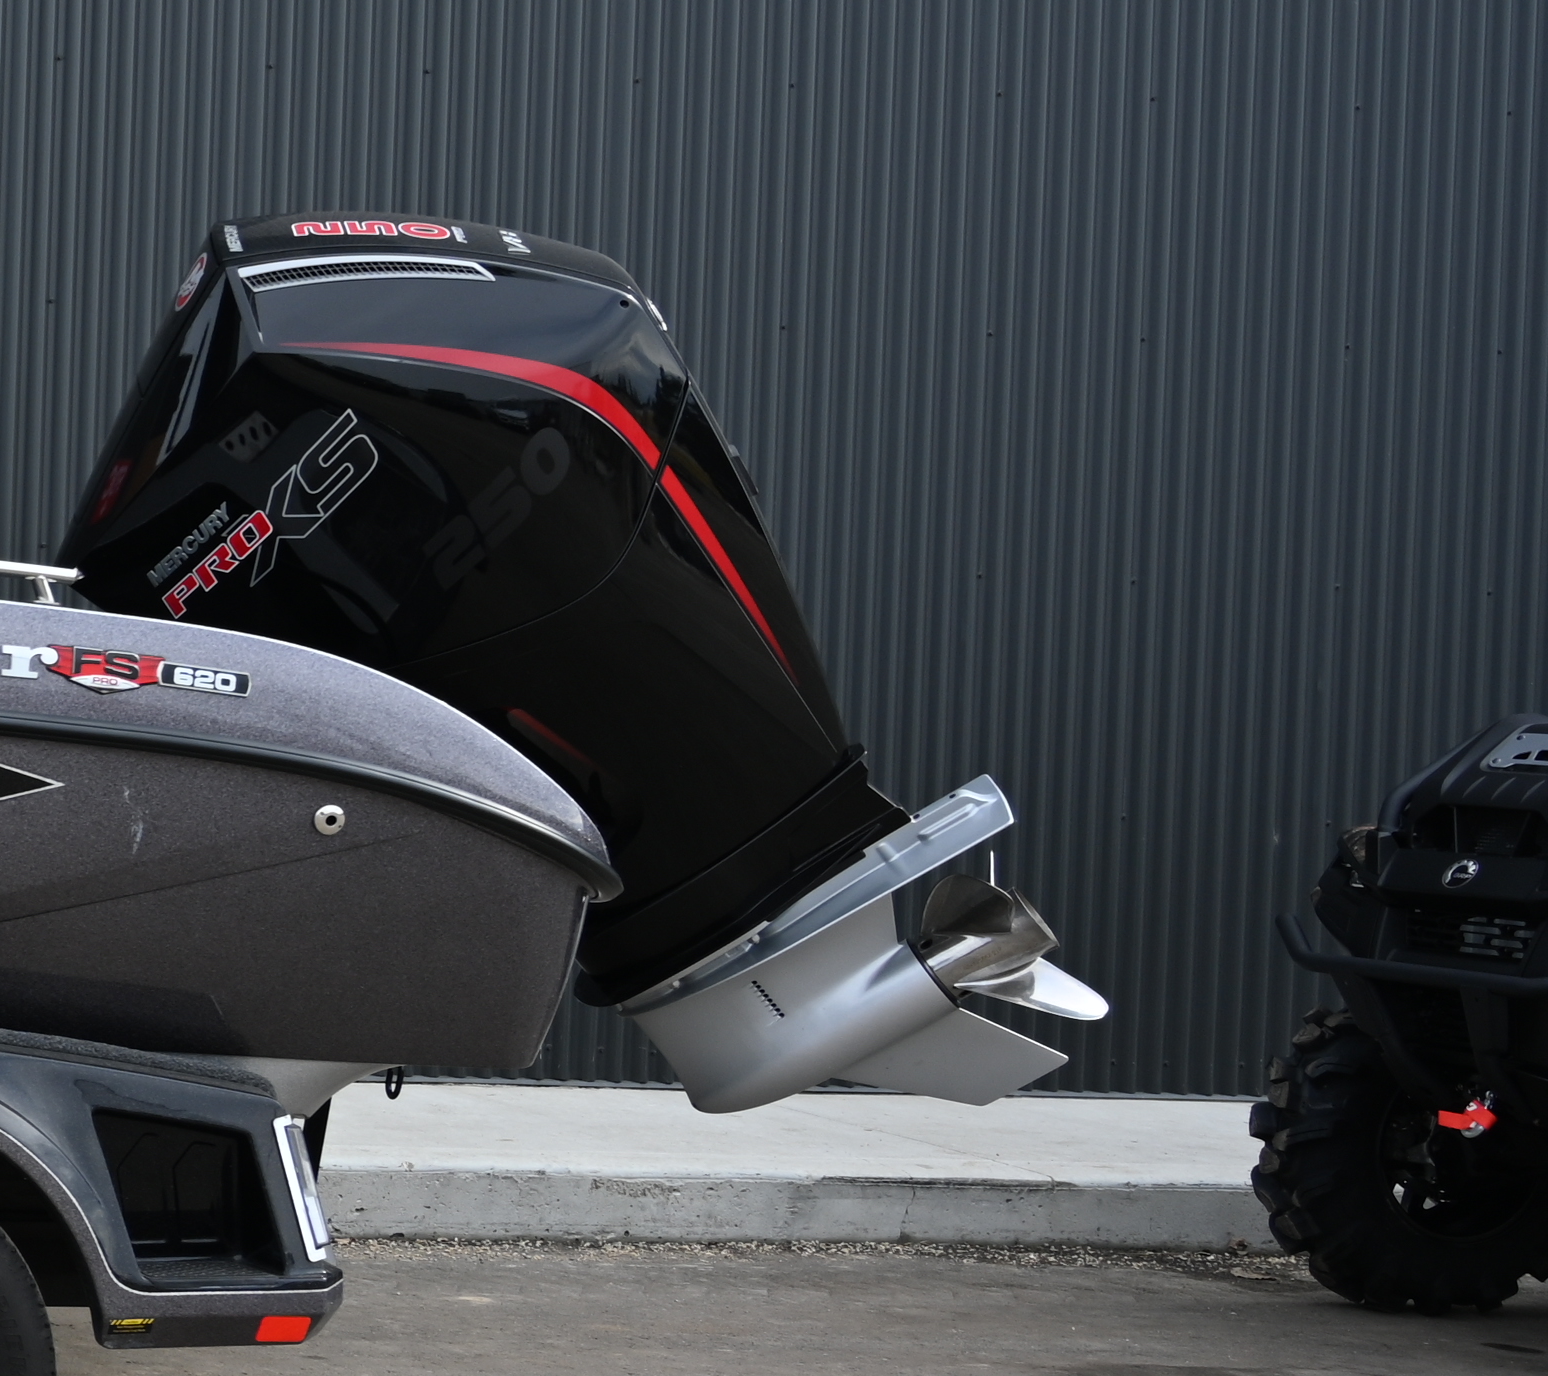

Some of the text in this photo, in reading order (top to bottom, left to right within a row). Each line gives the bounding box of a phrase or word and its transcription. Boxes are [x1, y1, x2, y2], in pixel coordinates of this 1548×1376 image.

[224, 225, 243, 253] MERCURY
[291, 220, 451, 240] 250
[420, 426, 571, 593] 250
[147, 501, 231, 588] MERCURY
[162, 509, 273, 619] PRO
[72, 645, 140, 680] FS
[173, 666, 237, 692] 620
[92, 676, 118, 686] PRO
